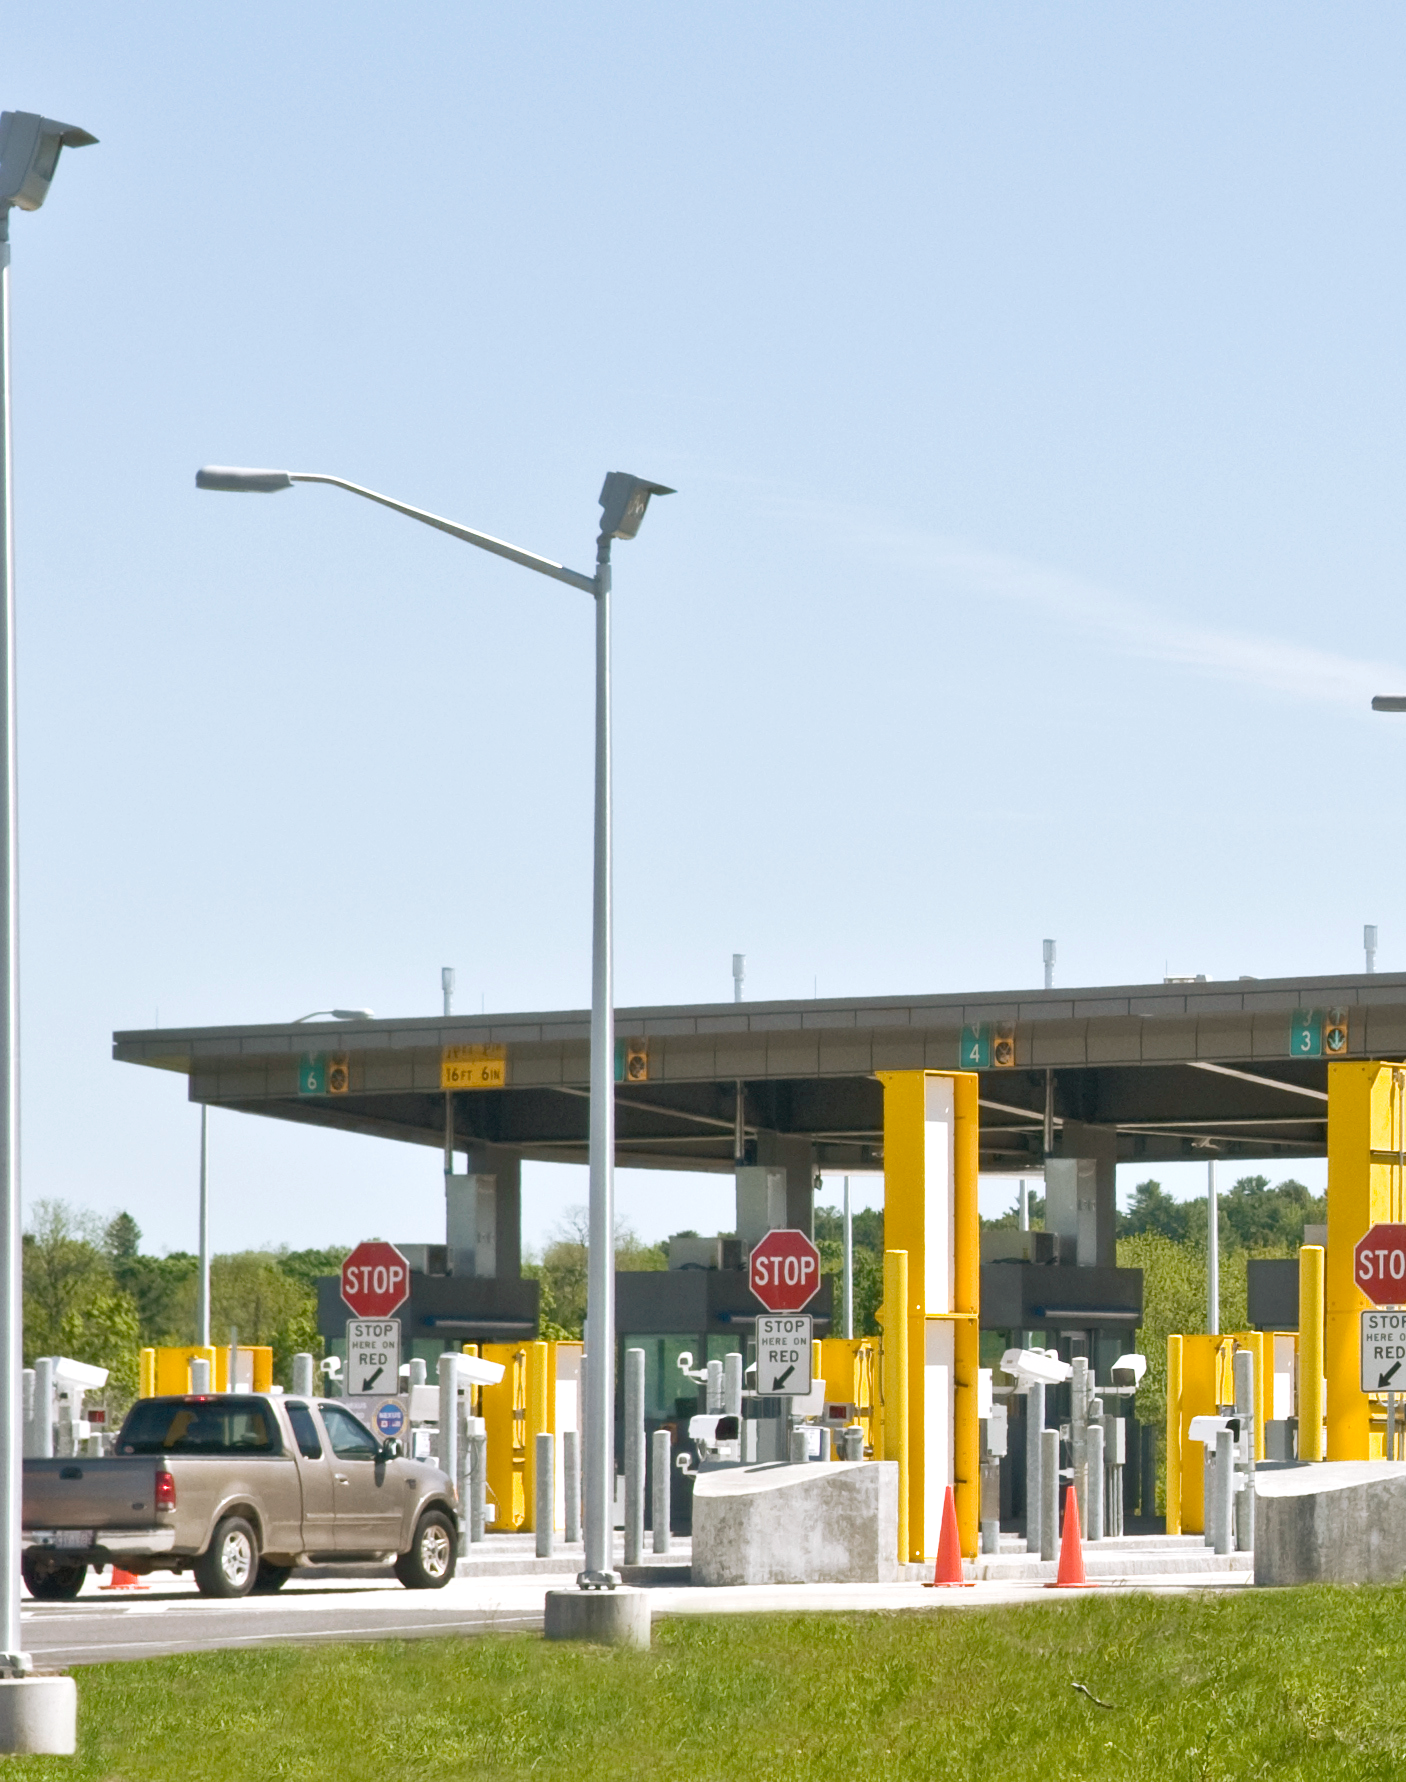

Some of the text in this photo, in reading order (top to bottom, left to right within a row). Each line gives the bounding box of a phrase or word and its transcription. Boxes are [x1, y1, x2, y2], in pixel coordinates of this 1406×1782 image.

[1300, 1030, 1311, 1051] 3
[970, 1044, 980, 1063] 4
[307, 1072, 317, 1090] 6
[754, 1256, 815, 1286] STOP
[346, 1266, 404, 1294] STOP
[354, 1324, 393, 1337] STOP
[764, 1320, 805, 1333] STOP
[762, 1338, 806, 1346] HERE ON
[1366, 1333, 1394, 1342] HERE
[352, 1341, 395, 1350] HERE ON
[359, 1353, 388, 1365] RED
[769, 1350, 799, 1363] RED
[1374, 1346, 1406, 1360] RED
